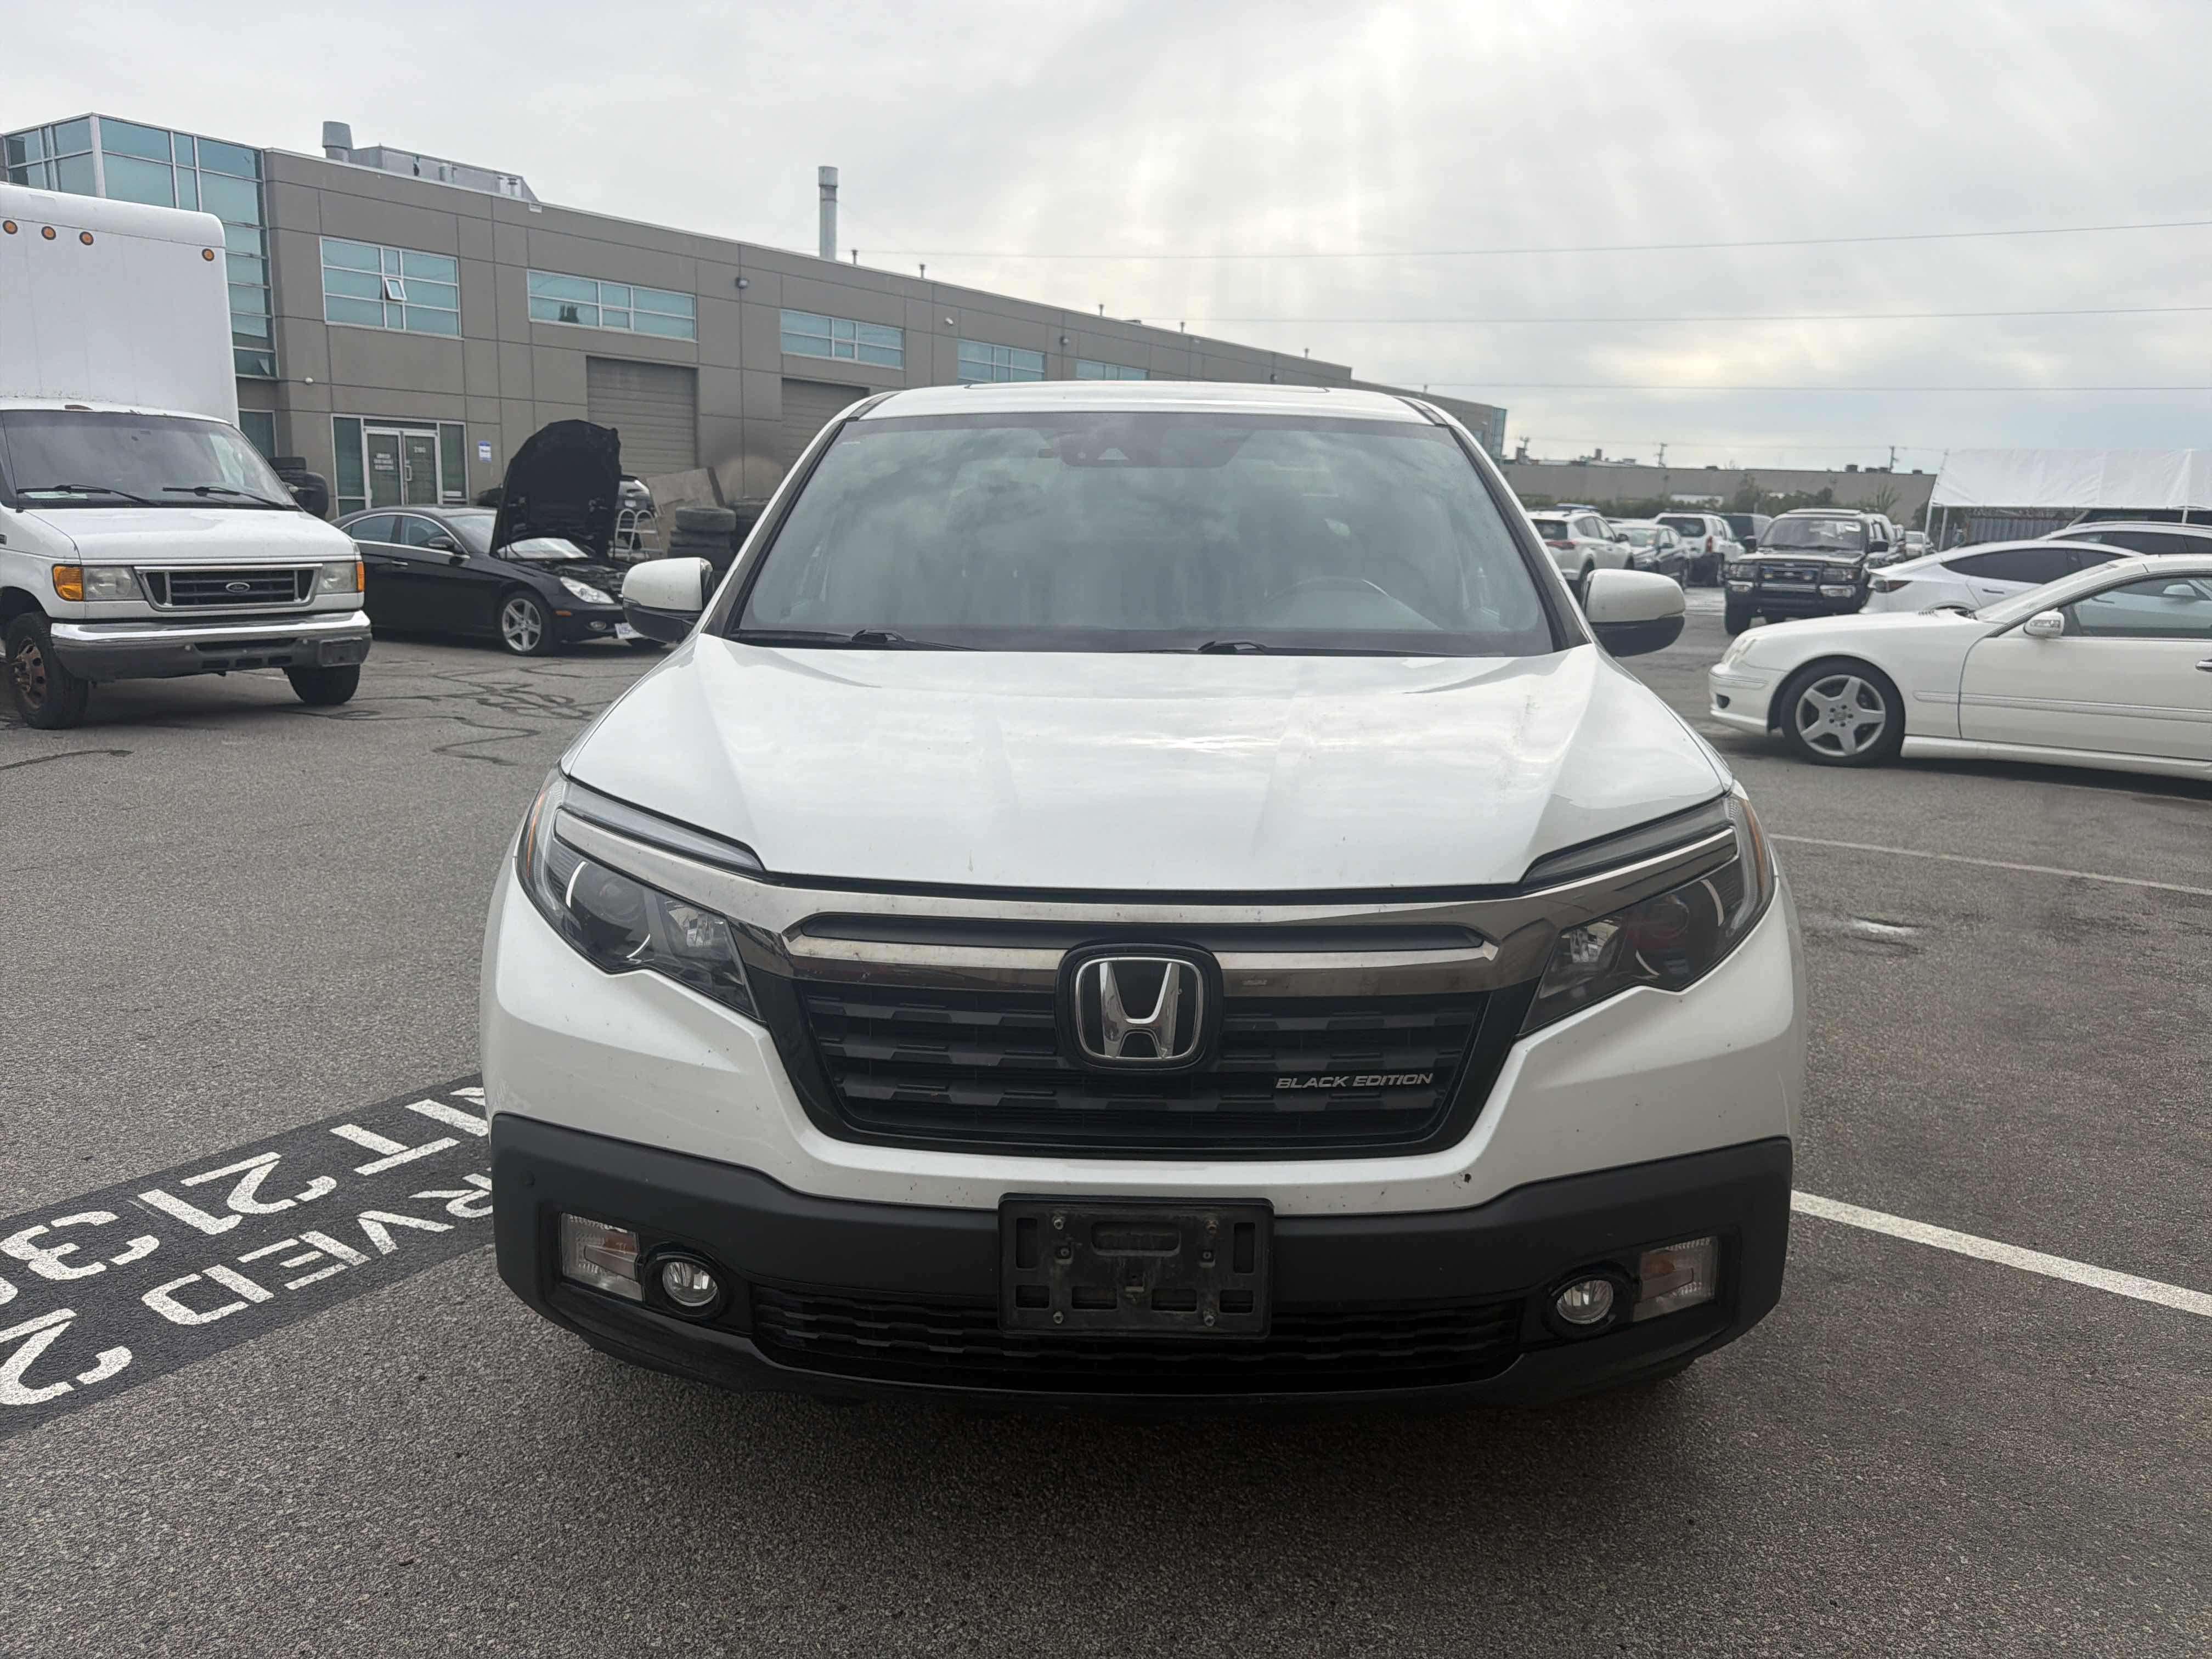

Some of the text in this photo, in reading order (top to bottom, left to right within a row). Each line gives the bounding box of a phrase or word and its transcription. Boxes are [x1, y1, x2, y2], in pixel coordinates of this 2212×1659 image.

[1275, 1073, 1433, 1088] BLACK EDITION
[0, 1152, 337, 1305] 213
[142, 1169, 493, 1325] RVED
